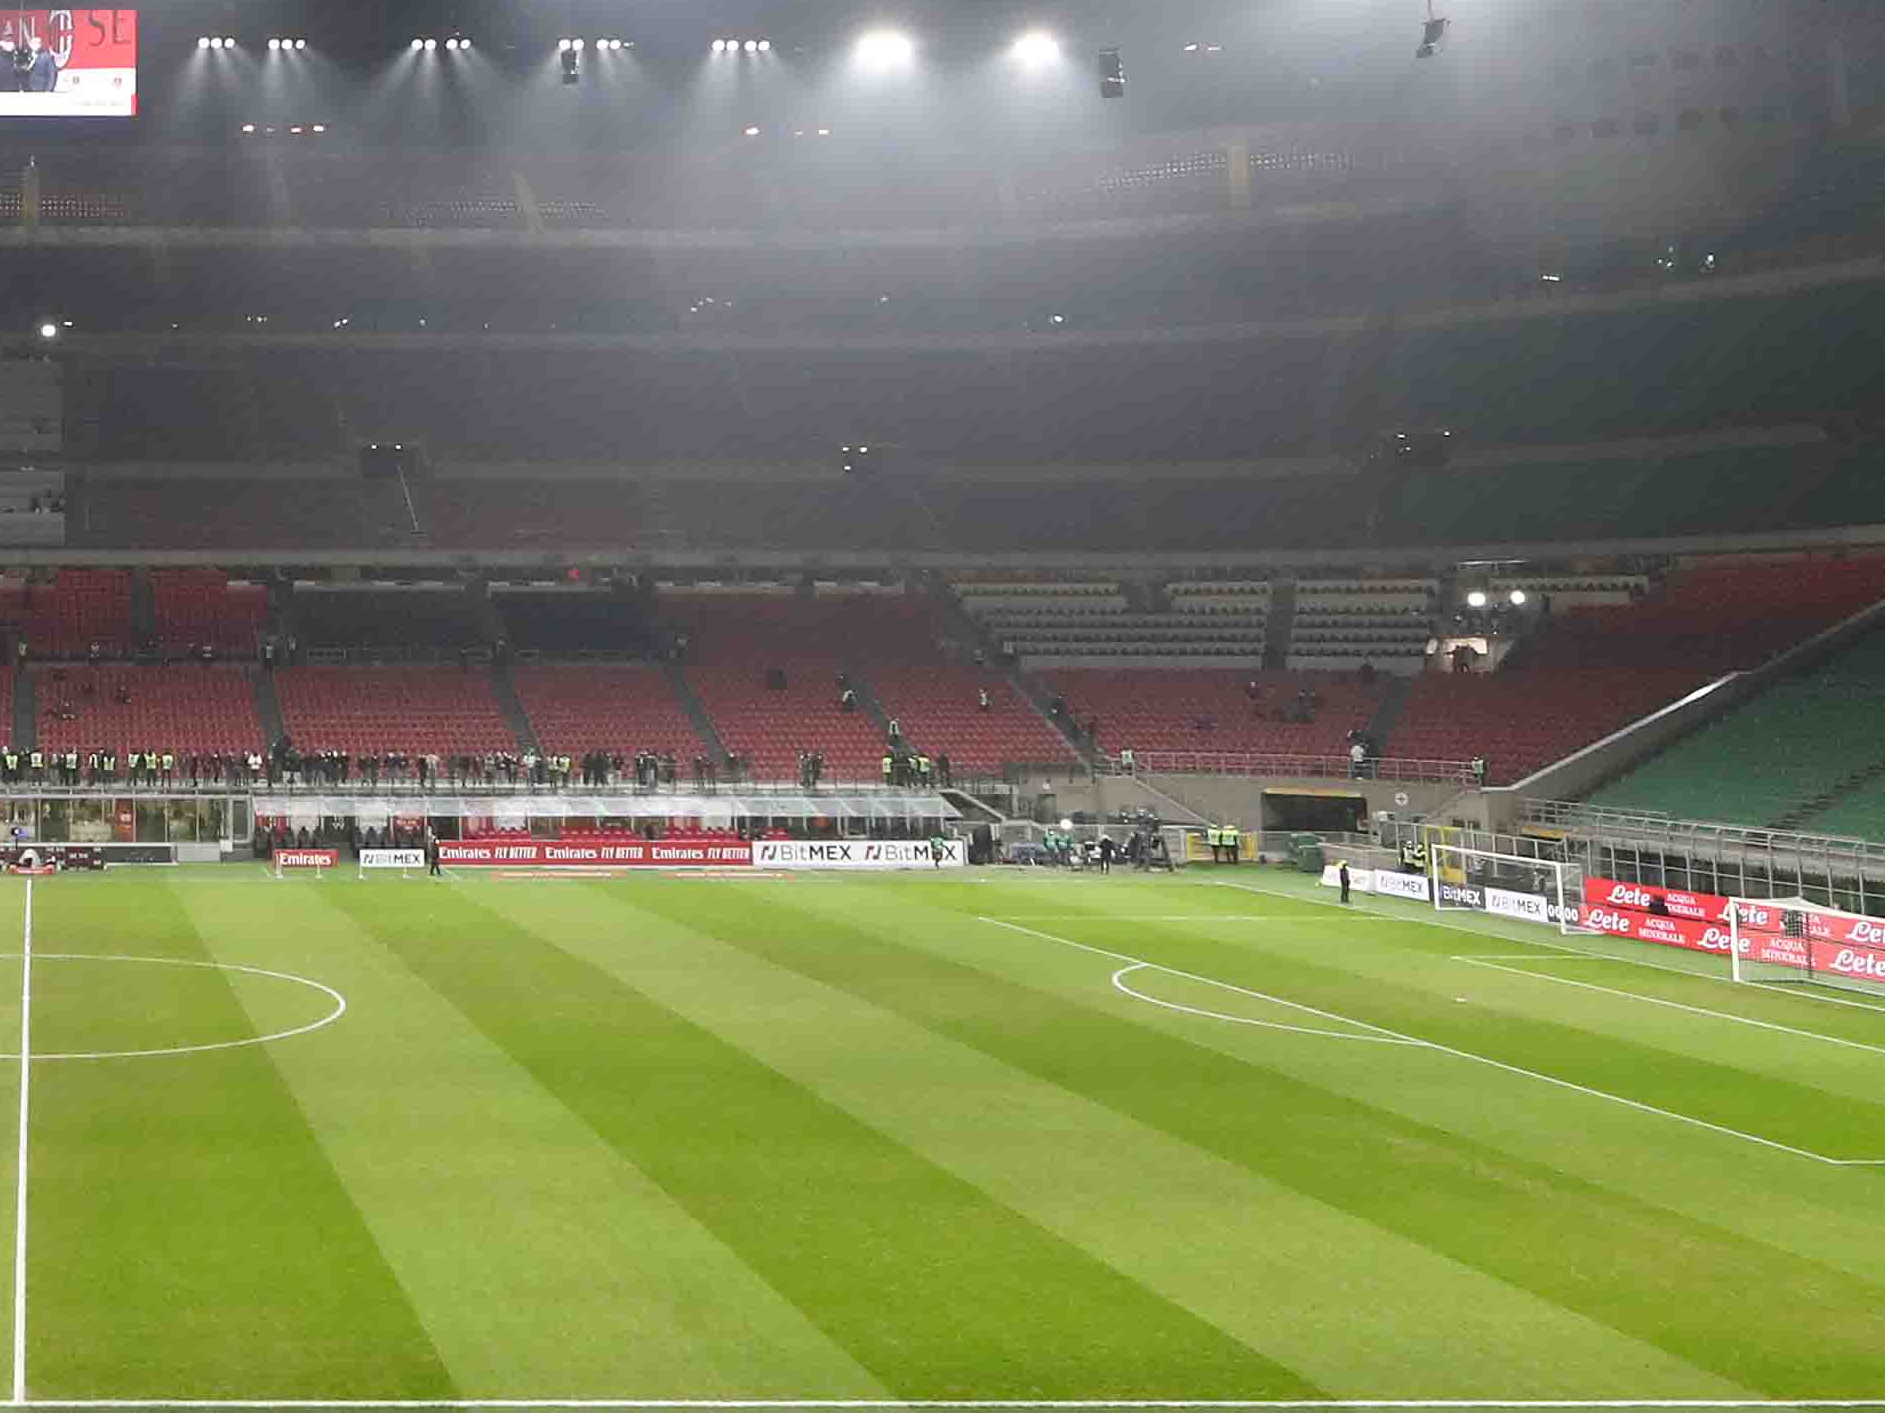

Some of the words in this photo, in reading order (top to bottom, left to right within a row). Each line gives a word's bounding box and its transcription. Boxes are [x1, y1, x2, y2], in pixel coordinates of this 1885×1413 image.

[439, 846, 491, 859] Emirates
[545, 846, 597, 859] Emirates
[651, 846, 704, 859] Emirates
[780, 845, 852, 861] BitMEX
[885, 845, 957, 861] BitMX
[1606, 884, 1652, 907] Lete
[1585, 909, 1630, 932] Lete
[1697, 928, 1751, 953] Lee
